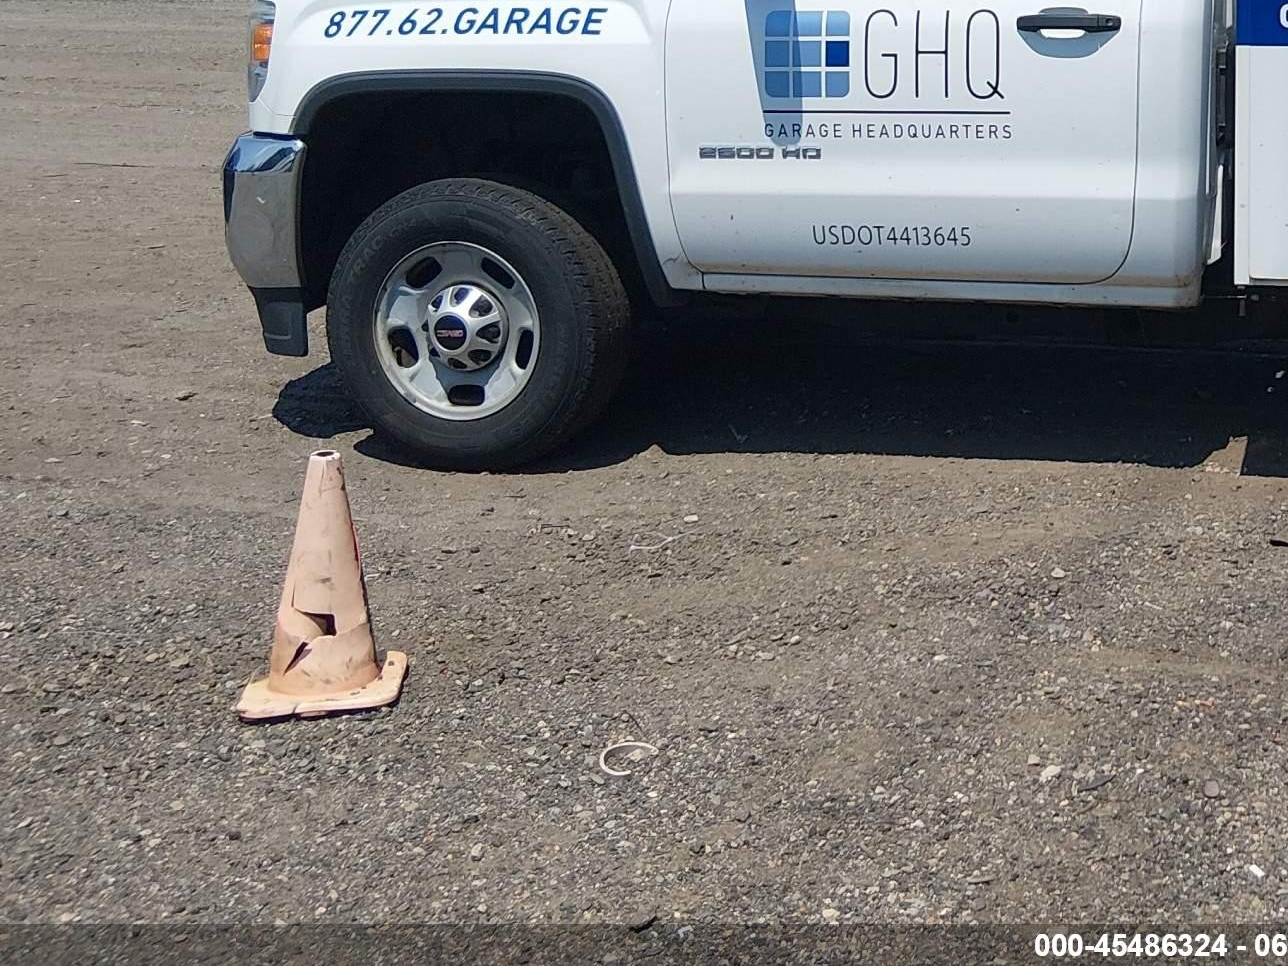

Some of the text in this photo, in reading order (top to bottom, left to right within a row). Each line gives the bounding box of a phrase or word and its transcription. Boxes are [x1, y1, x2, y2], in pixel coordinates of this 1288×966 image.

[323, 6, 609, 39] 877.62.GARAGE
[863, 9, 1006, 100] GHQ
[764, 122, 1013, 140] GARAGE HEADQUARTERS
[699, 146, 822, 160] 2500 HD
[811, 224, 973, 248] USDOT4413645
